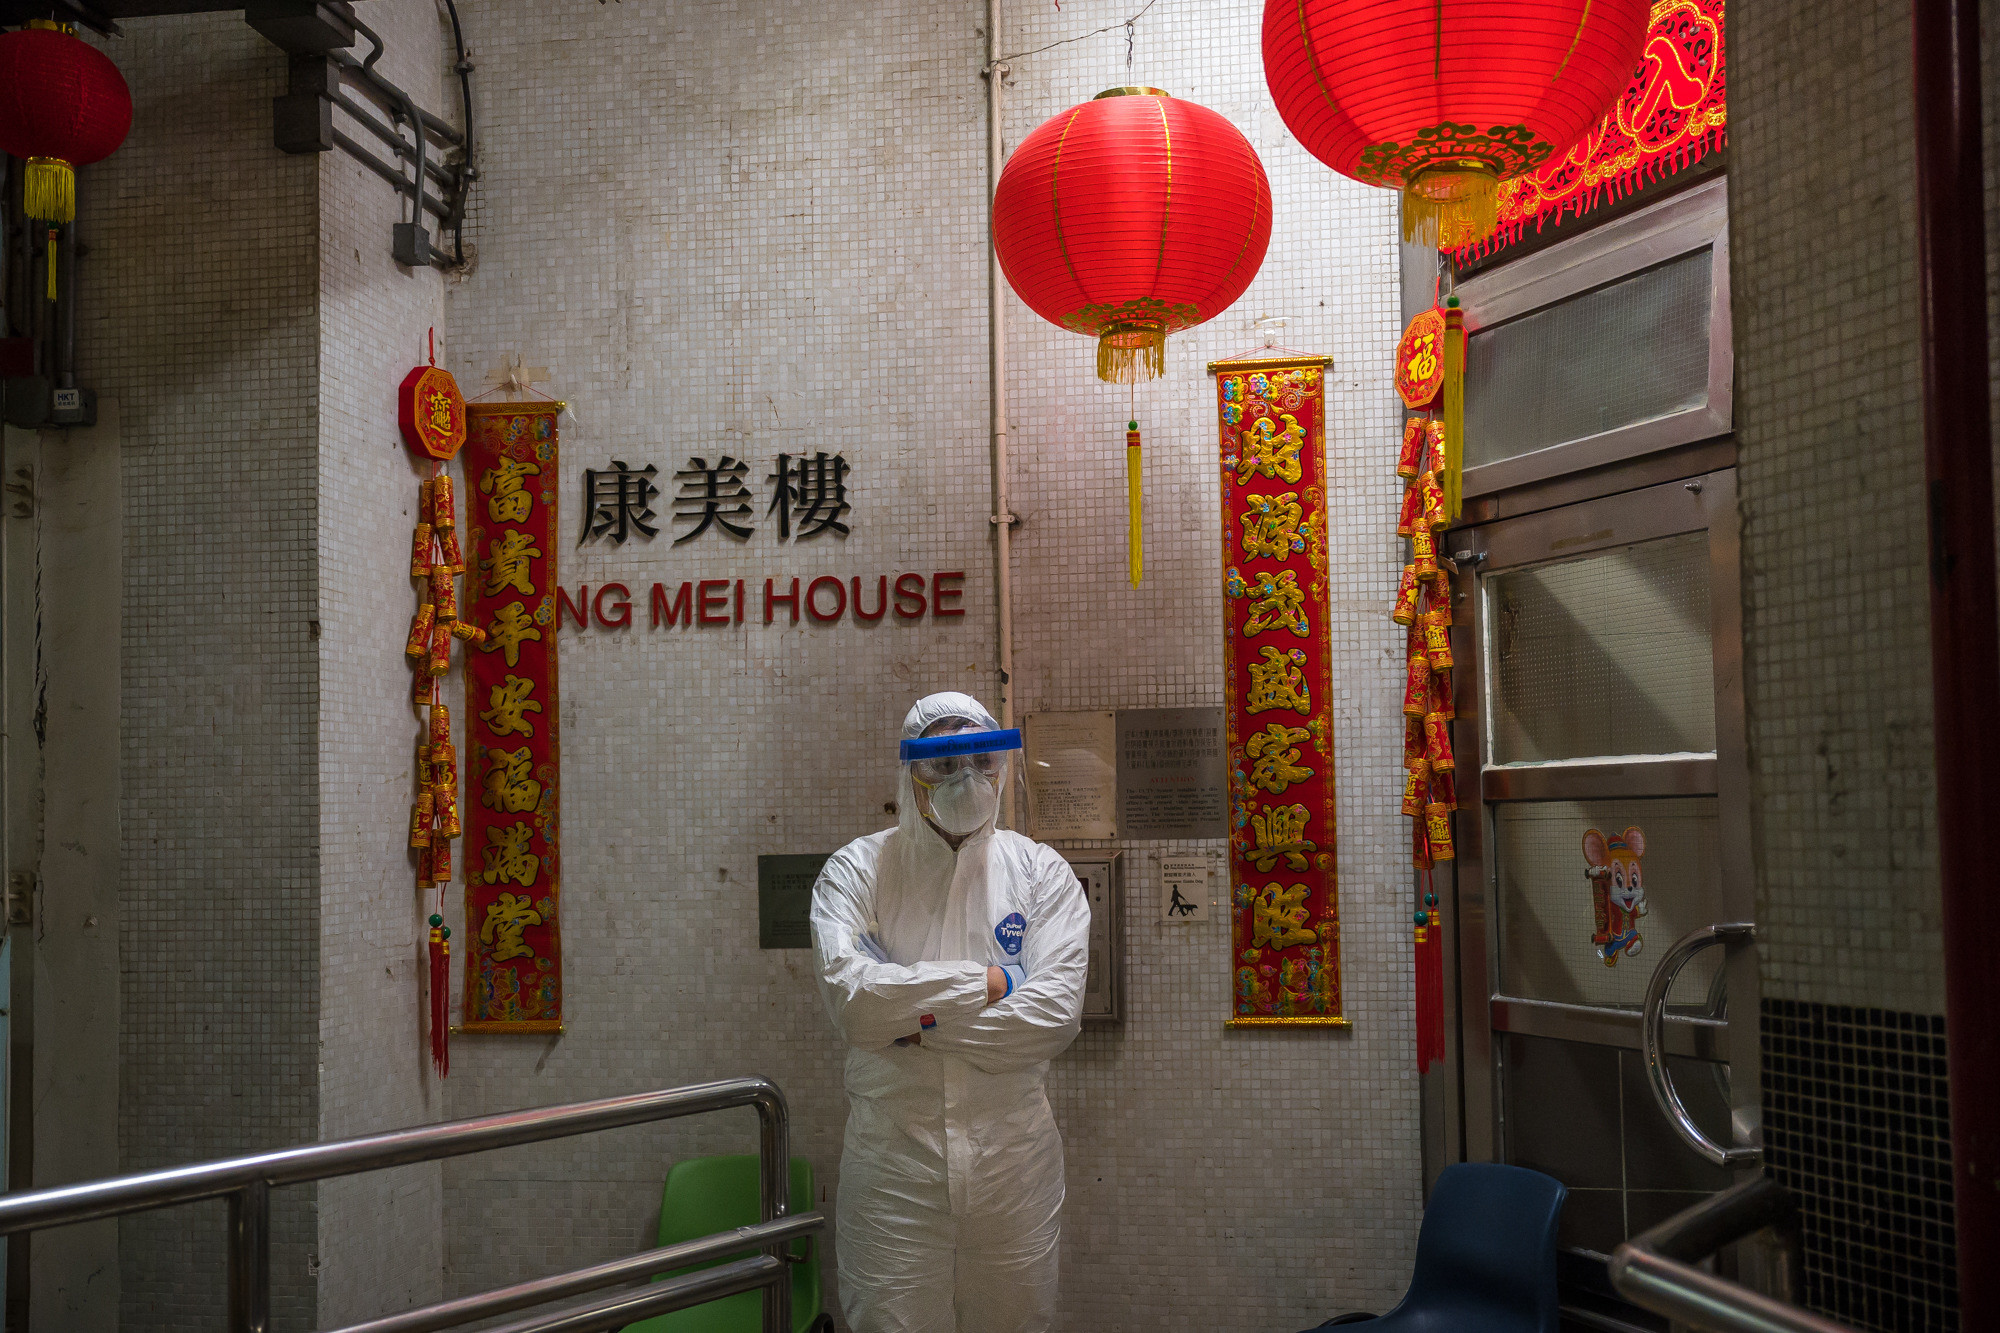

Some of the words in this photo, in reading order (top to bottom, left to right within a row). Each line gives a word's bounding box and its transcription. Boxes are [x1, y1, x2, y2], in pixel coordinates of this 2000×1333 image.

[1407, 332, 1437, 384] 福
[57, 393, 75, 401] HKT
[579, 451, 852, 546] 康美樓
[652, 579, 744, 627] MEI
[765, 571, 966, 624] HOUSE
